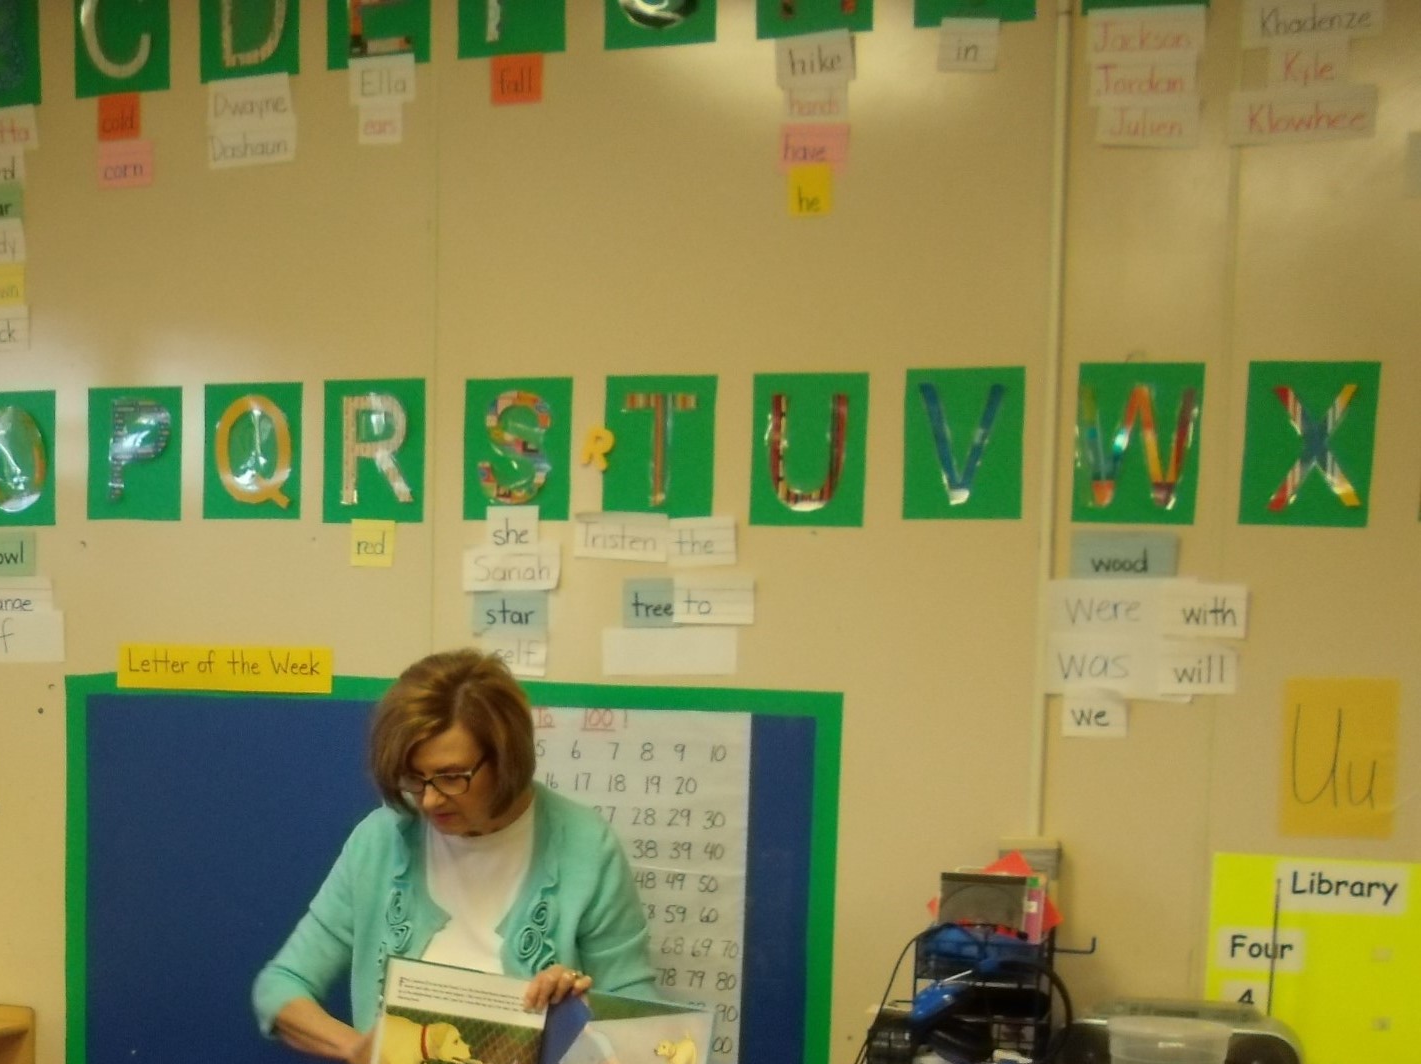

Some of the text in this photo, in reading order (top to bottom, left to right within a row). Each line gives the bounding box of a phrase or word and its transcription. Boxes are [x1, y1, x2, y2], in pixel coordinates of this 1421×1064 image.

[788, 44, 841, 76] hike
[954, 39, 979, 62] in
[360, 68, 406, 97] Ella
[213, 92, 287, 119] Dwayne
[782, 133, 828, 162] have
[102, 163, 144, 181] corn
[796, 186, 821, 212] he
[109, 396, 172, 502] P
[214, 393, 293, 509] Q
[341, 391, 414, 505] R
[478, 390, 553, 505] S
[581, 425, 615, 472] R
[623, 392, 698, 507] T
[765, 393, 850, 512] U
[918, 382, 1006, 506] V
[1075, 384, 1200, 510] W
[1268, 384, 1361, 512] X
[356, 523, 386, 557] red
[492, 517, 529, 547] she
[580, 520, 658, 551] Tristen
[674, 528, 715, 555] the
[1090, 547, 1149, 574] wood
[485, 598, 535, 625] star
[631, 592, 674, 618] tree
[682, 590, 712, 615] to
[1065, 596, 1142, 626] Were
[1182, 594, 1238, 627] with
[128, 647, 321, 677] Letter of the Week
[1057, 651, 1130, 680] Was
[1173, 653, 1226, 684] will
[1070, 707, 1110, 728] we
[535, 740, 727, 763] 5 6 7 8 9 10
[1291, 702, 1377, 810] Uu
[573, 772, 592, 792] 17
[607, 774, 627, 793] 18
[644, 775, 661, 794] 19
[675, 776, 698, 795] 20
[631, 807, 656, 826] 28
[667, 808, 691, 827] 29
[703, 810, 726, 830] 30
[632, 839, 725, 860] 38 39 40
[634, 871, 719, 893] 48 49 50
[1290, 870, 1399, 906] Library
[664, 904, 687, 924] 59
[699, 906, 719, 923] 60
[660, 936, 739, 959] 68 69 70
[1229, 933, 1295, 960] Four
[655, 967, 737, 991] 78 79 80
[715, 1003, 738, 1023] 90
